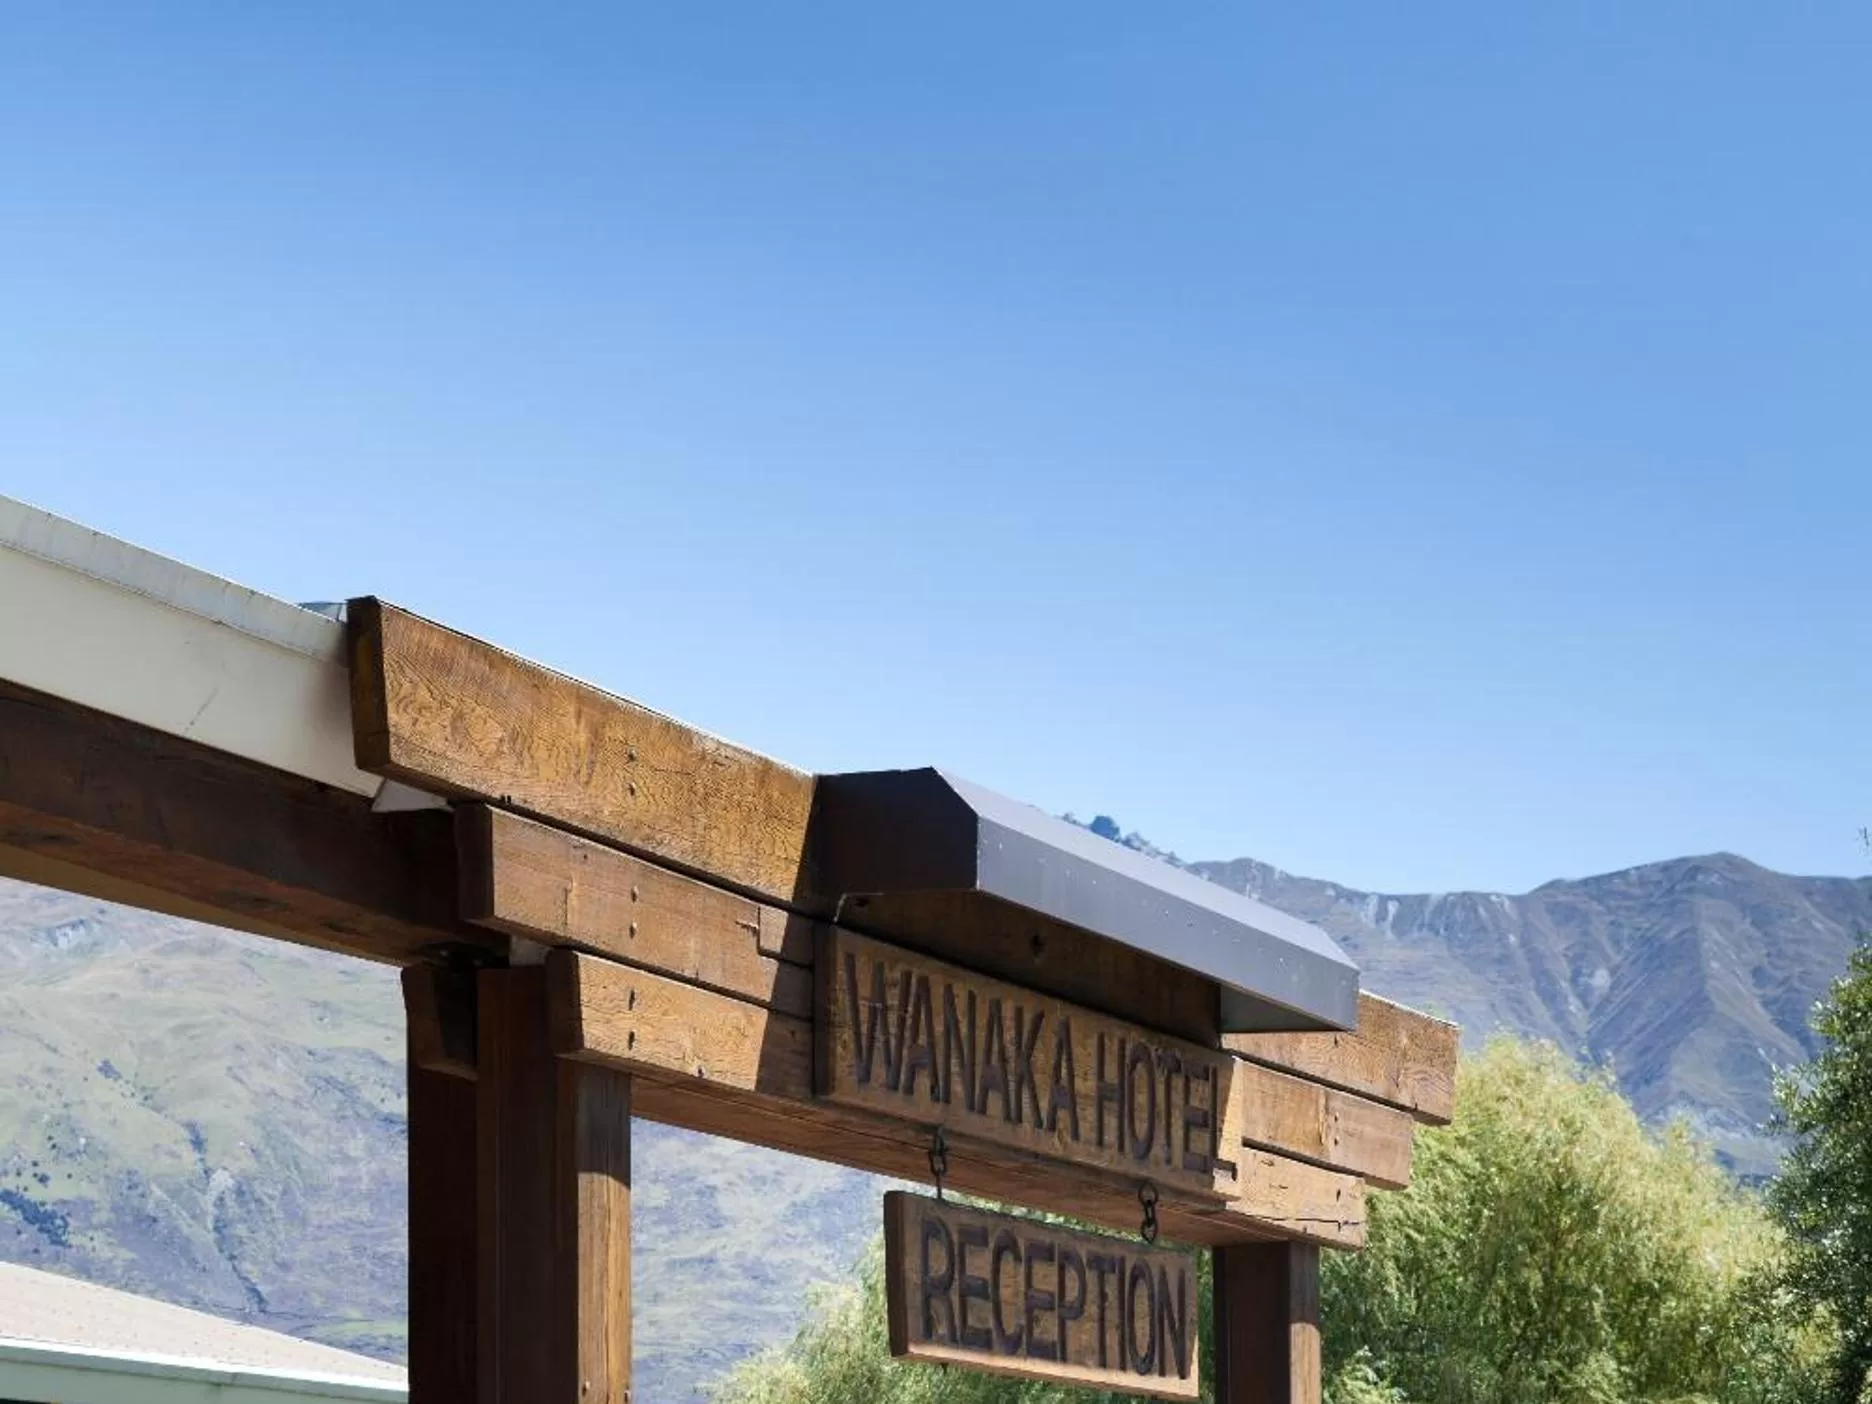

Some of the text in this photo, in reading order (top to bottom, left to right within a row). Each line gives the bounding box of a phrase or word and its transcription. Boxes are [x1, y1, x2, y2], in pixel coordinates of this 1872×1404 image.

[844, 952, 1238, 1182] WANAKA HOTEL
[920, 1213, 1187, 1381] RECEPTION
